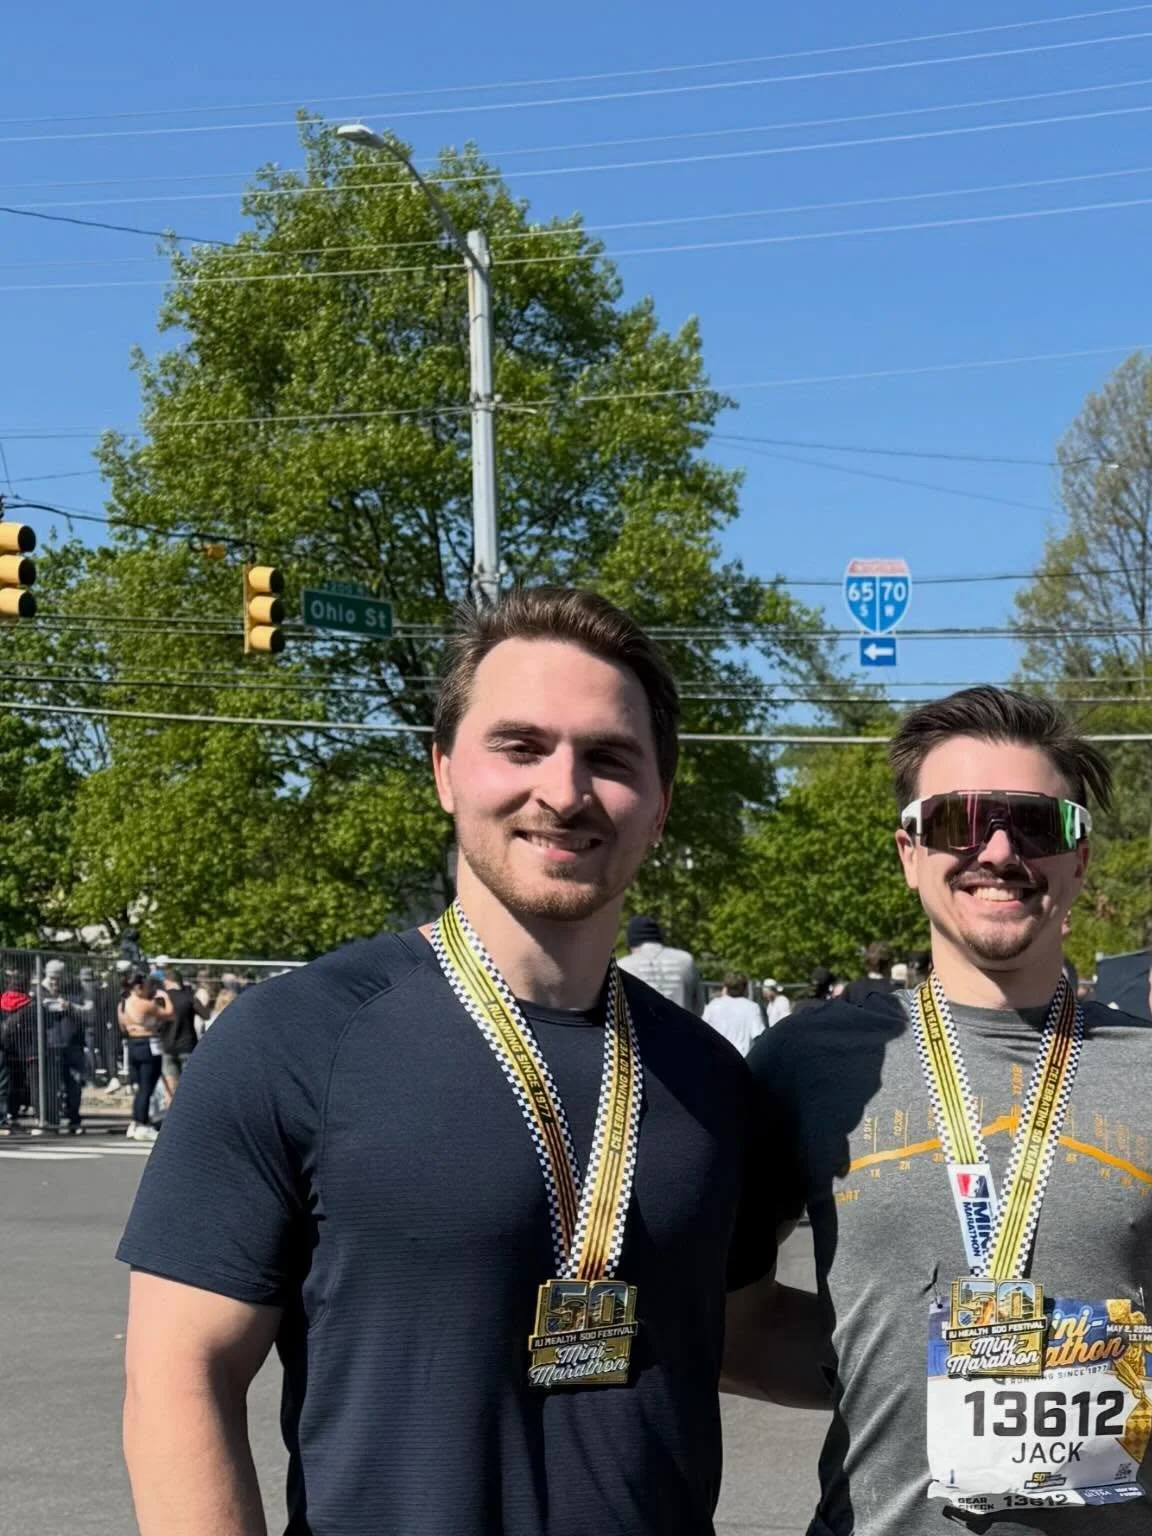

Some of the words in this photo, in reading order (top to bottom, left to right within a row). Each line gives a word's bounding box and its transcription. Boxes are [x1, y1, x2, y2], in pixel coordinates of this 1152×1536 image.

[848, 582, 874, 602] 65
[881, 582, 906, 602] 70
[310, 600, 357, 625] Ohio
[364, 607, 387, 629] St
[488, 1003, 523, 1053] RUNNING
[515, 1053, 541, 1089] SINCE
[534, 1091, 552, 1120] 1977
[1035, 1066, 1059, 1129] CELEBRATING
[611, 1077, 629, 1151] CELEBRATING
[962, 1201, 982, 1256] MARATHON
[972, 1202, 991, 1253] MIN
[544, 1334, 577, 1346] HEALTH
[579, 1331, 597, 1341] 500
[597, 1325, 635, 1338] FESTIVAL
[958, 1328, 989, 1338] HEALTH
[991, 1325, 1007, 1334] 500
[1008, 1321, 1044, 1332] FESTIVAL
[1107, 1325, 1122, 1333] MAY
[946, 1350, 1040, 1375] Marathon
[1045, 1337, 1126, 1367] athon
[529, 1355, 630, 1386] Marathon
[1058, 1369, 1084, 1379] SINCE
[964, 1390, 1125, 1438] 13612
[1011, 1441, 1085, 1464] JACK
[958, 1497, 988, 1505] GEAR
